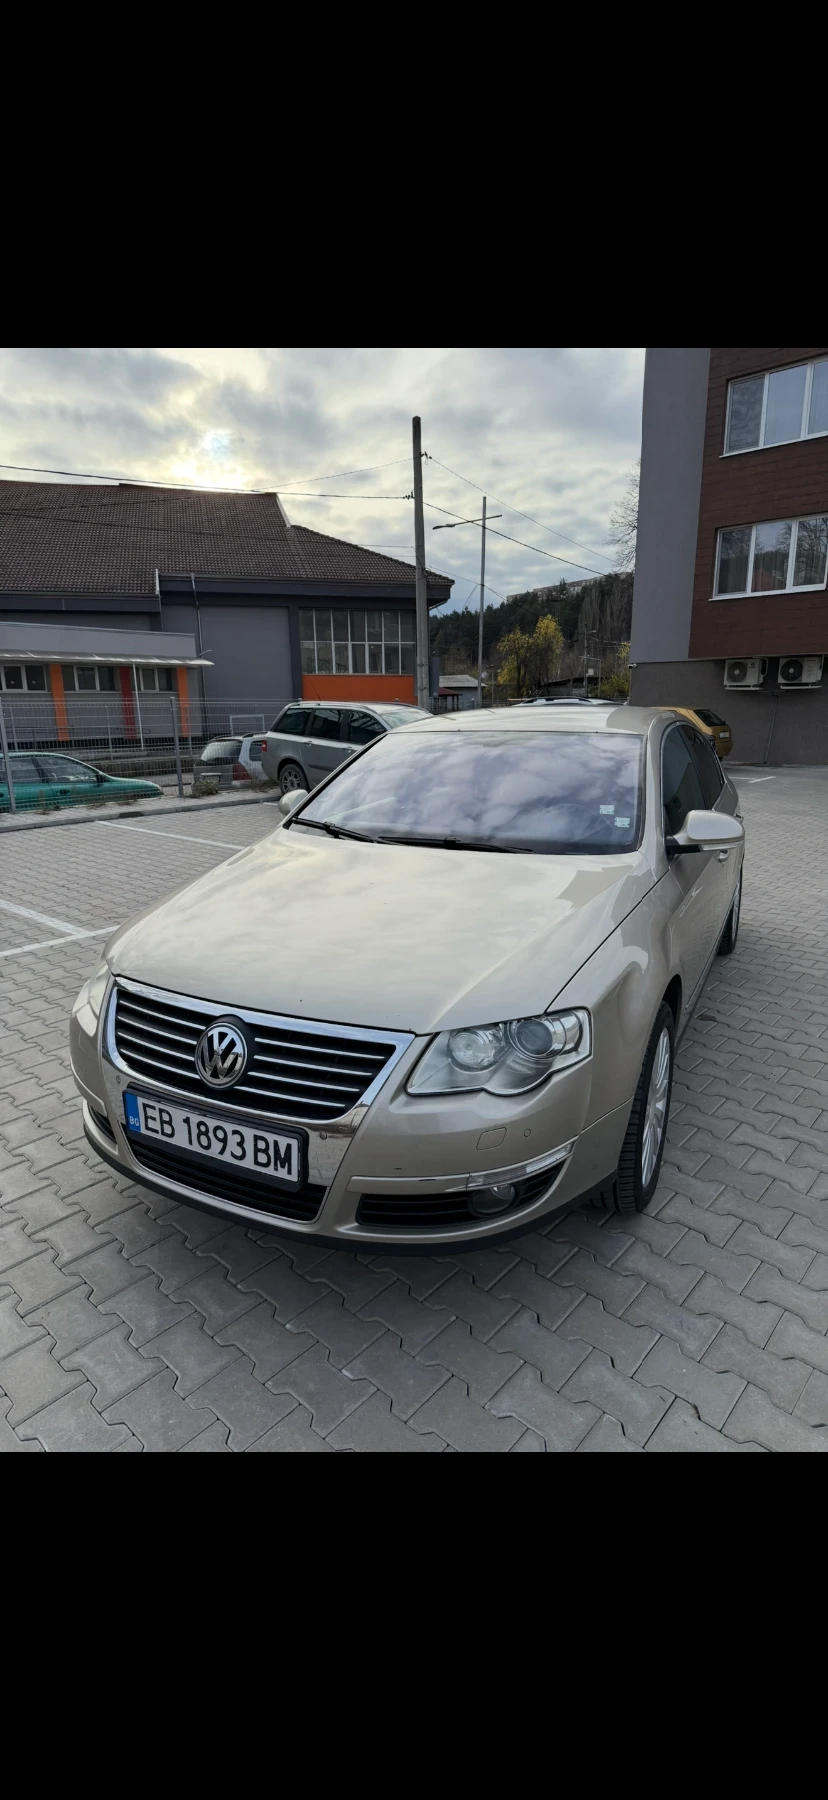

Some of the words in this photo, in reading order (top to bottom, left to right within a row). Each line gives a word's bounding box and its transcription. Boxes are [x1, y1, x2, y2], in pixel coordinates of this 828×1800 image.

[198, 1025, 245, 1086] VW
[129, 1115, 140, 1126] BG
[142, 1102, 175, 1138] EB
[182, 1116, 246, 1160] 1893
[253, 1134, 292, 1175] BM
